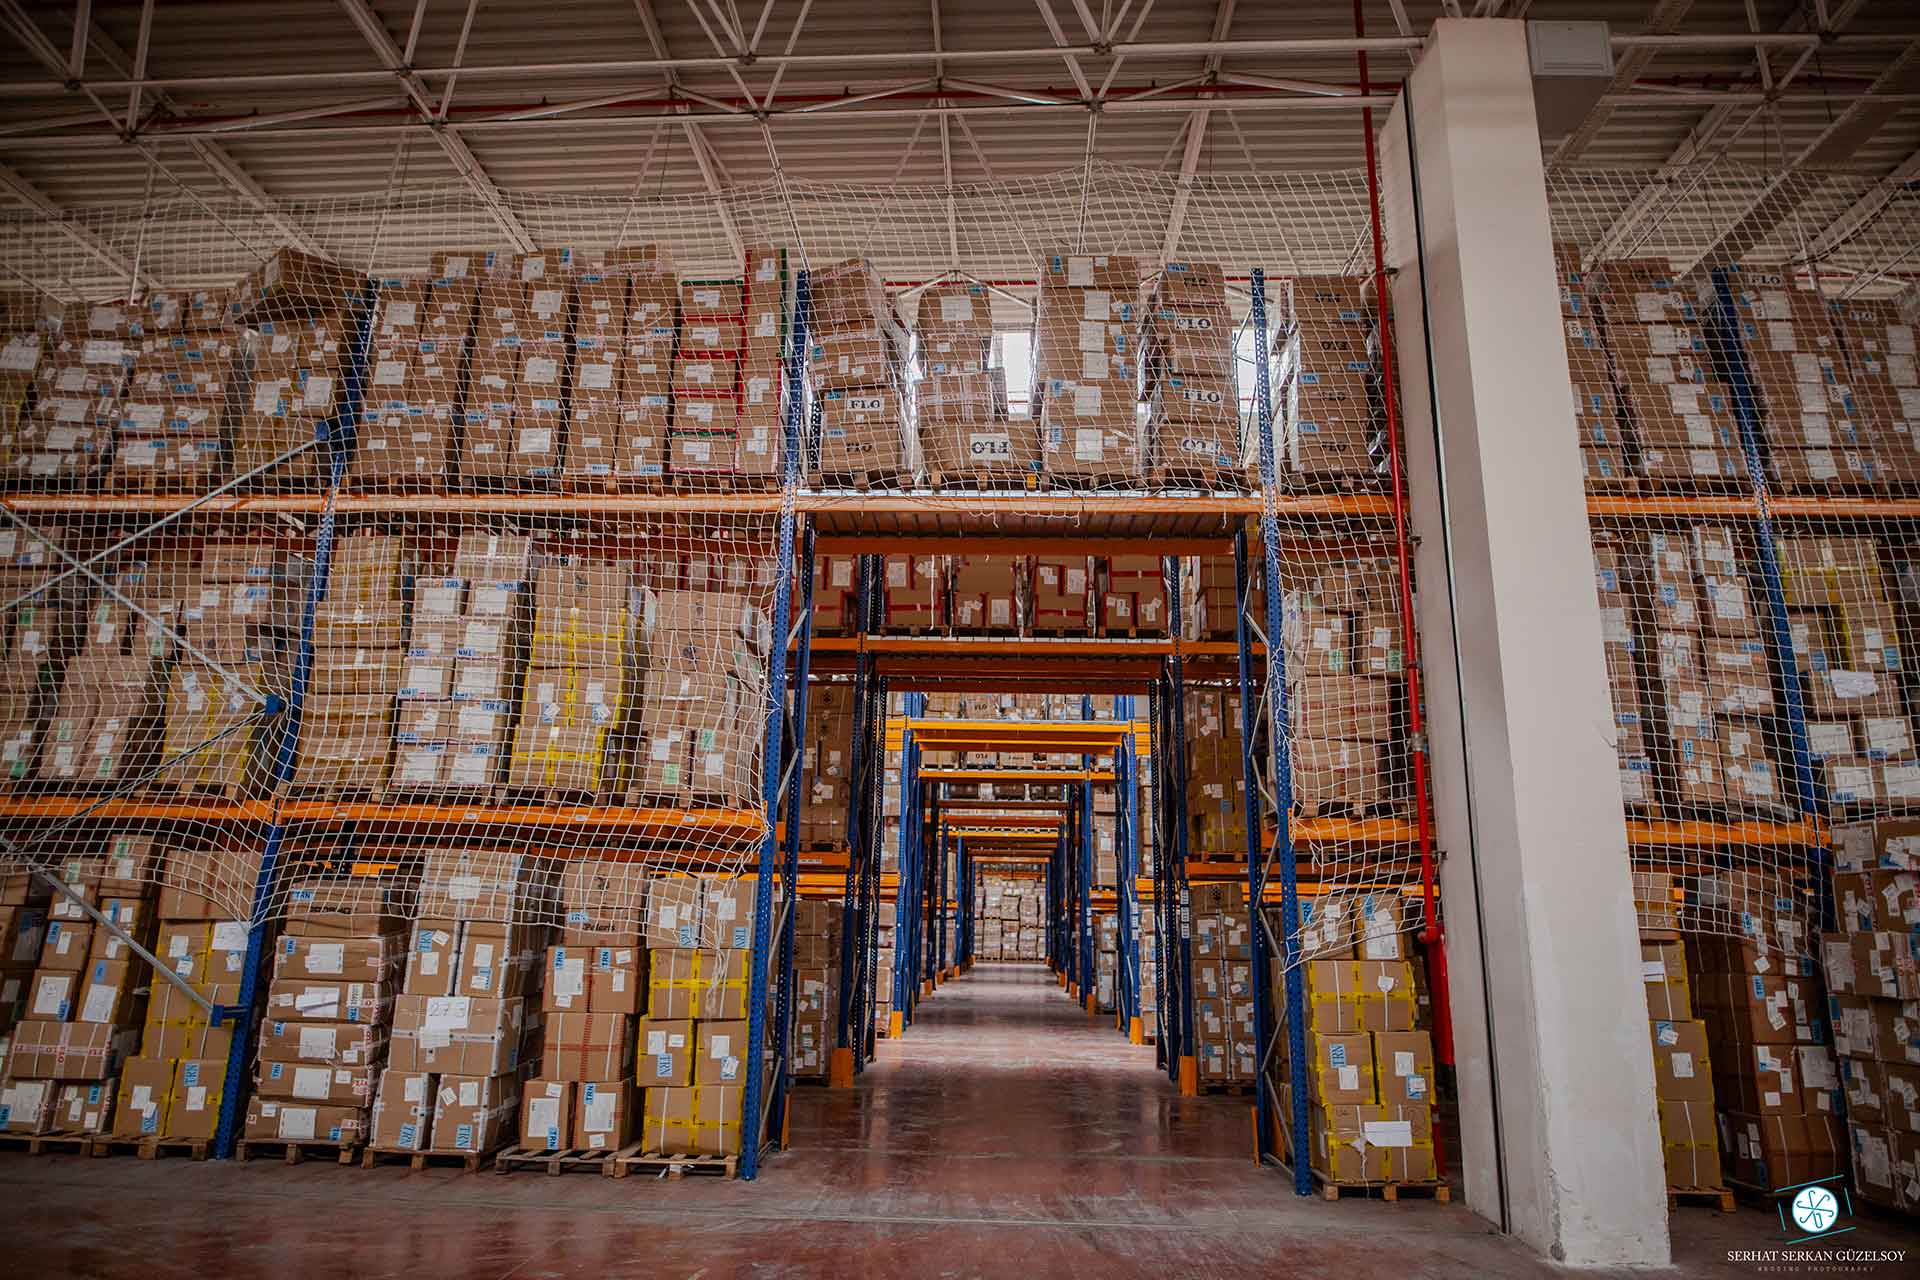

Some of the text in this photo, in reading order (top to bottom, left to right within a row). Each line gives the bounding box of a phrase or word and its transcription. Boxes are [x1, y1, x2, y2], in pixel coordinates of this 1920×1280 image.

[851, 399, 881, 409] FLO
[1184, 389, 1220, 402] FLO
[971, 441, 1009, 454] FLO
[419, 931, 432, 950] TRN
[735, 928, 746, 947] TRN
[659, 1055, 671, 1075] TRN
[1332, 1045, 1345, 1067] TRN
[185, 1064, 198, 1086] TRN
[403, 1126, 416, 1146] TRN
[458, 1126, 471, 1146] TRN
